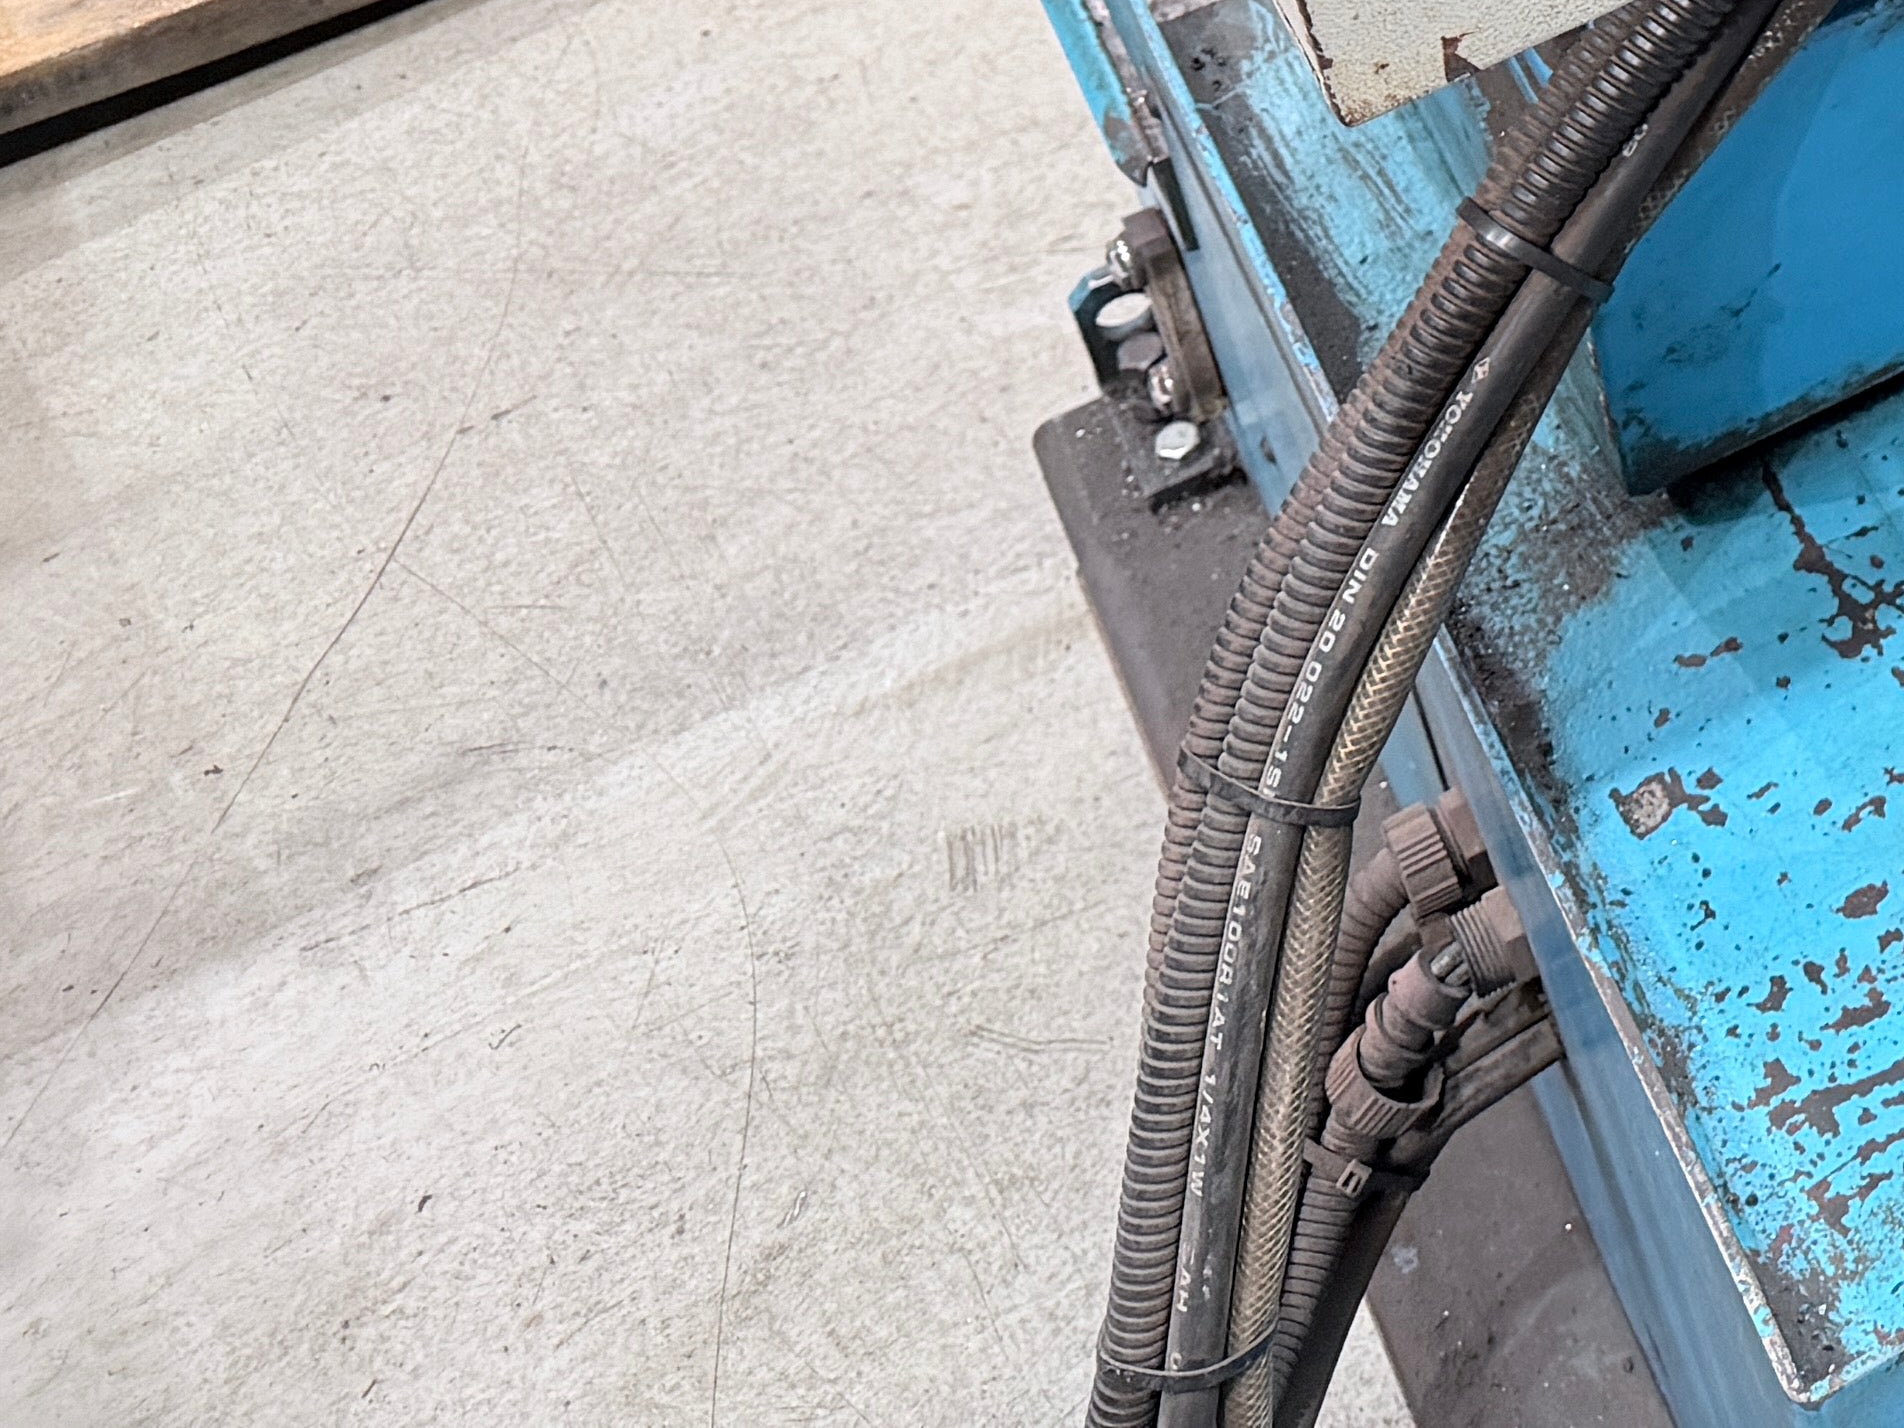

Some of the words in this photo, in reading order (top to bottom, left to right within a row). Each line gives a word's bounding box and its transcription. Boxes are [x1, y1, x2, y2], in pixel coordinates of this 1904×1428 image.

[1380, 390, 1474, 527] YOKOHAMA
[1318, 608, 1347, 654] 20
[1341, 546, 1379, 604] DIN
[1209, 834, 1262, 1051] SAE100R1AT
[1190, 1072, 1218, 1198] 1/4X1W
